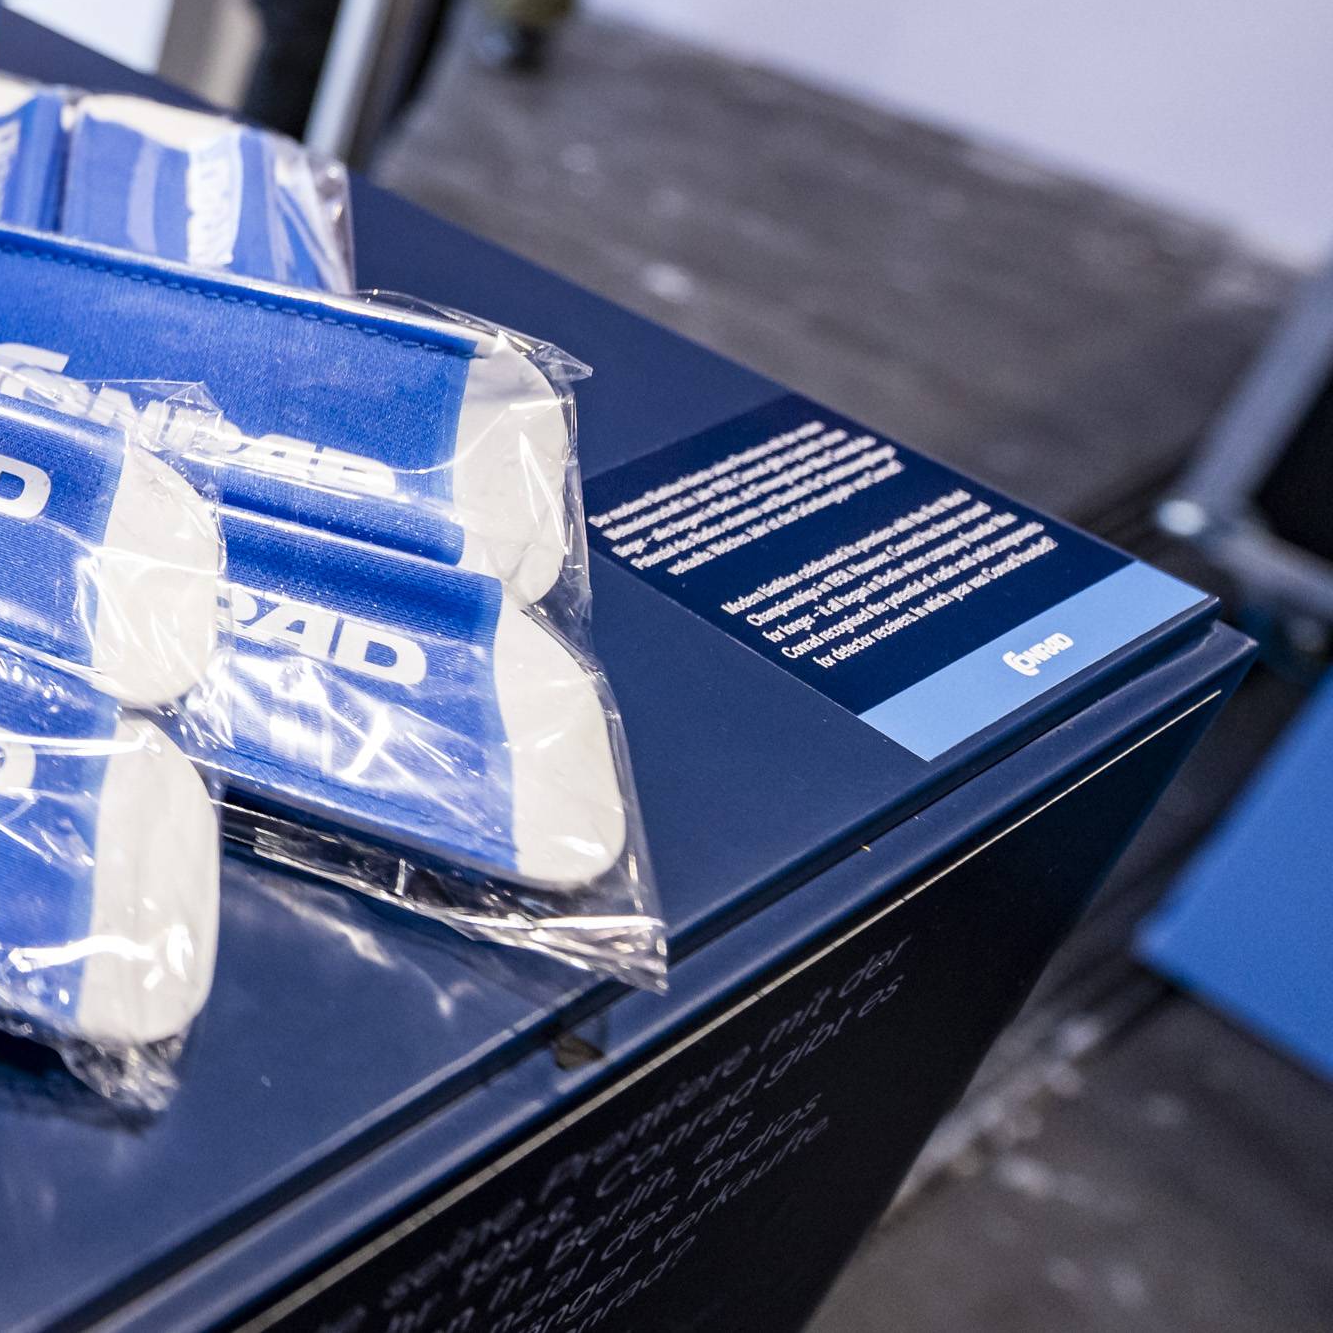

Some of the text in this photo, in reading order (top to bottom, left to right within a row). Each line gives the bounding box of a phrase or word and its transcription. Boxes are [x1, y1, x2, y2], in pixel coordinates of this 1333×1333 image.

[760, 986, 833, 1052] mit
[839, 935, 913, 998] der
[596, 1063, 766, 1198] Conrad
[764, 1007, 853, 1089] gibt
[858, 974, 906, 1018] es
[693, 1111, 754, 1165] als
[600, 1196, 679, 1261] des
[687, 1093, 823, 1202] Radios
[653, 1116, 830, 1254] verkaufte
